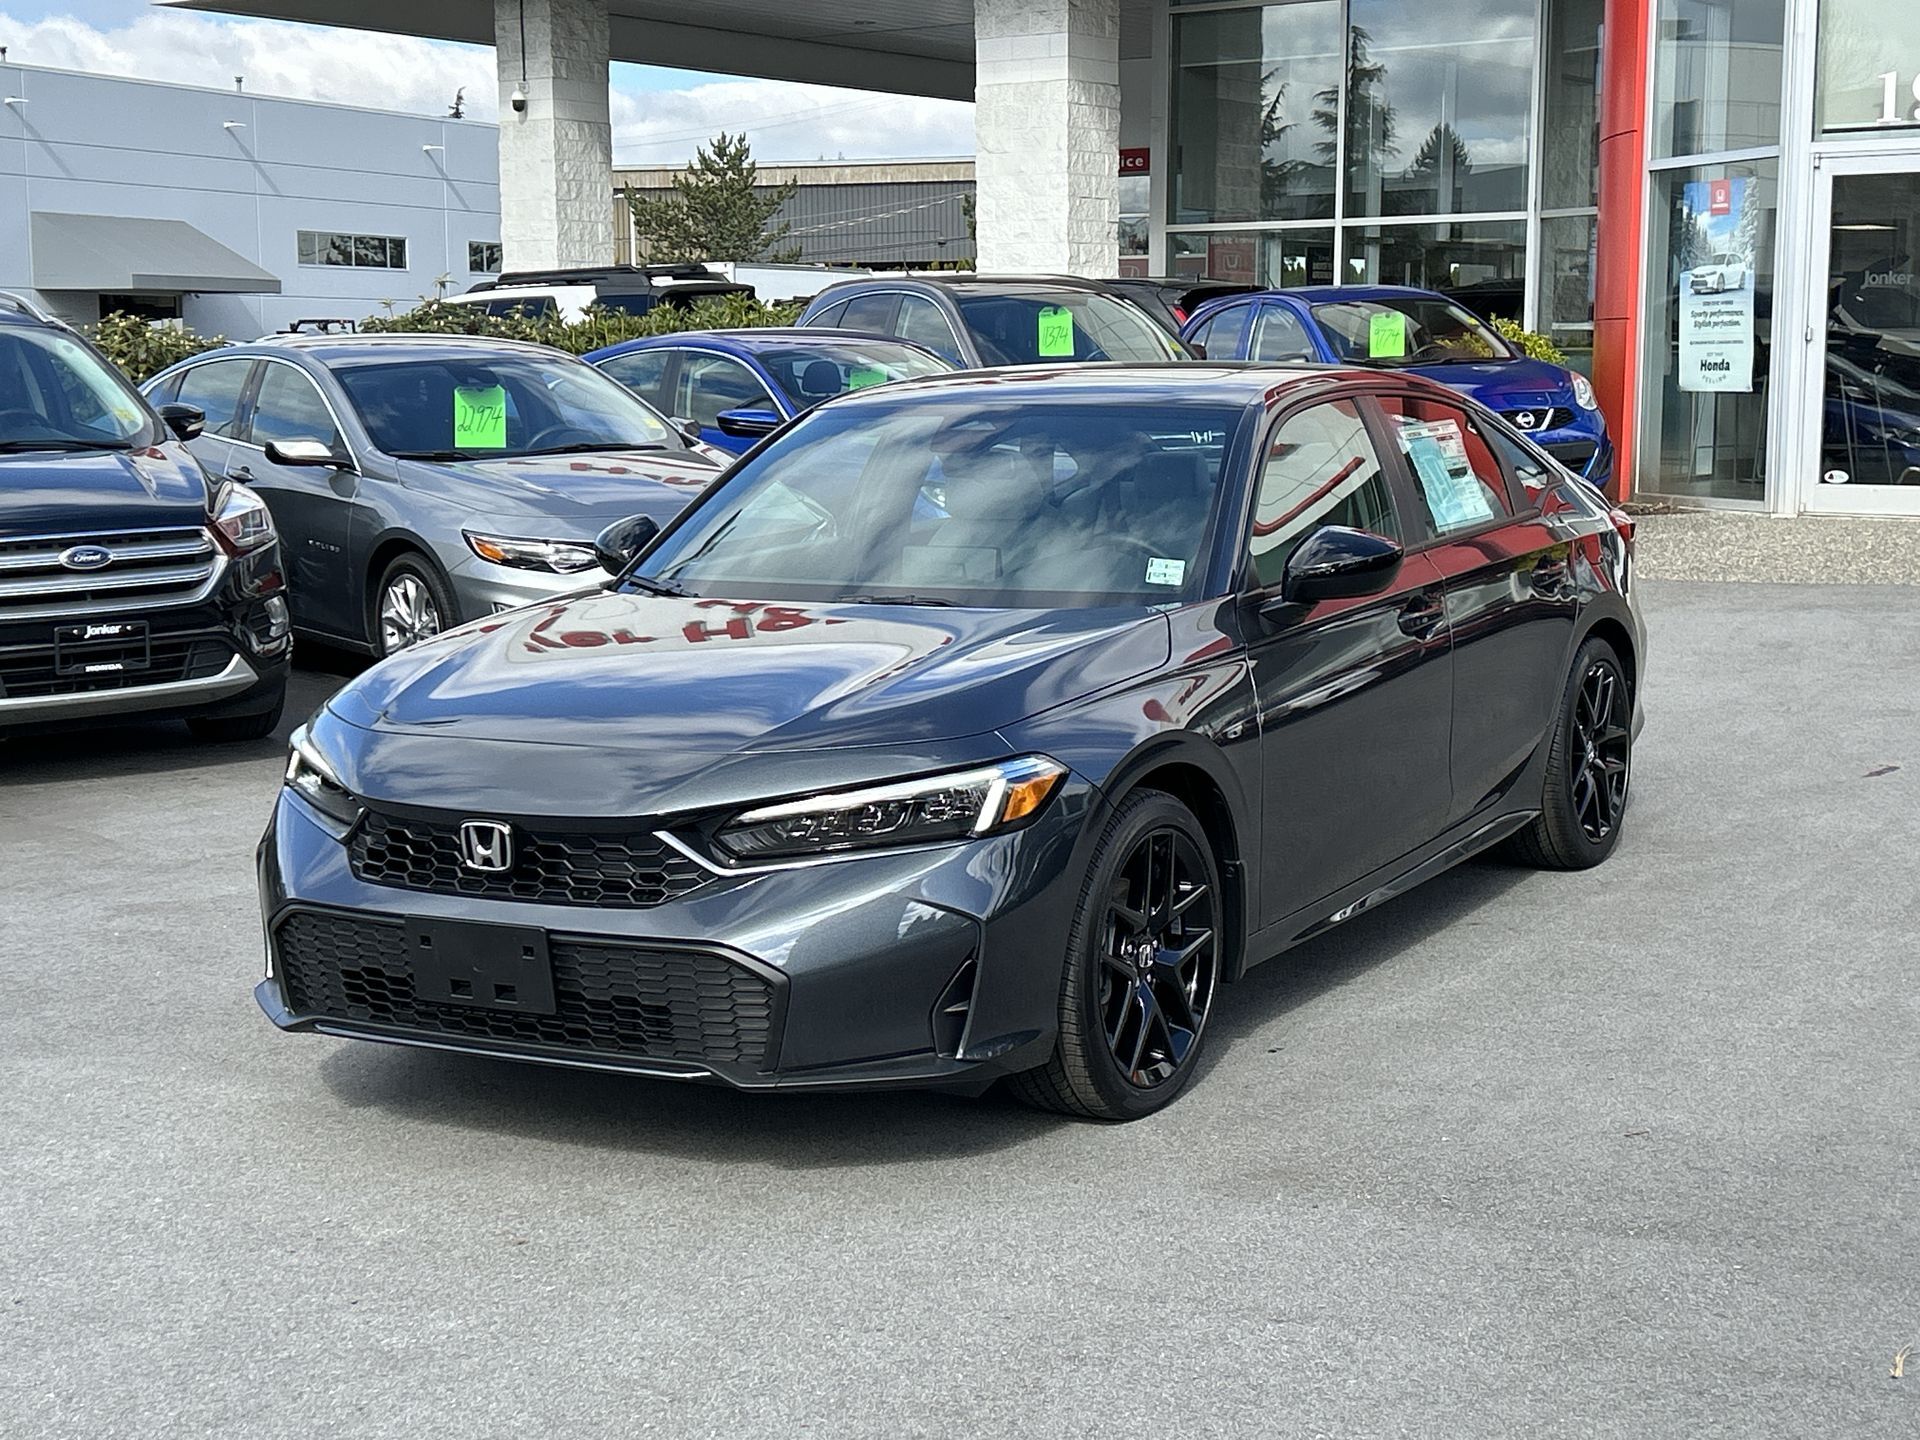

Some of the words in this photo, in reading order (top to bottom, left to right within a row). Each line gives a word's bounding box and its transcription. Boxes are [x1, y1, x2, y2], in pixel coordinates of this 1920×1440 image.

[1860, 270, 1914, 290] Jonker
[1700, 358, 1730, 371] Honda
[73, 551, 102, 563] Ford
[84, 624, 122, 639] Jonker
[85, 663, 123, 672] HONDA
